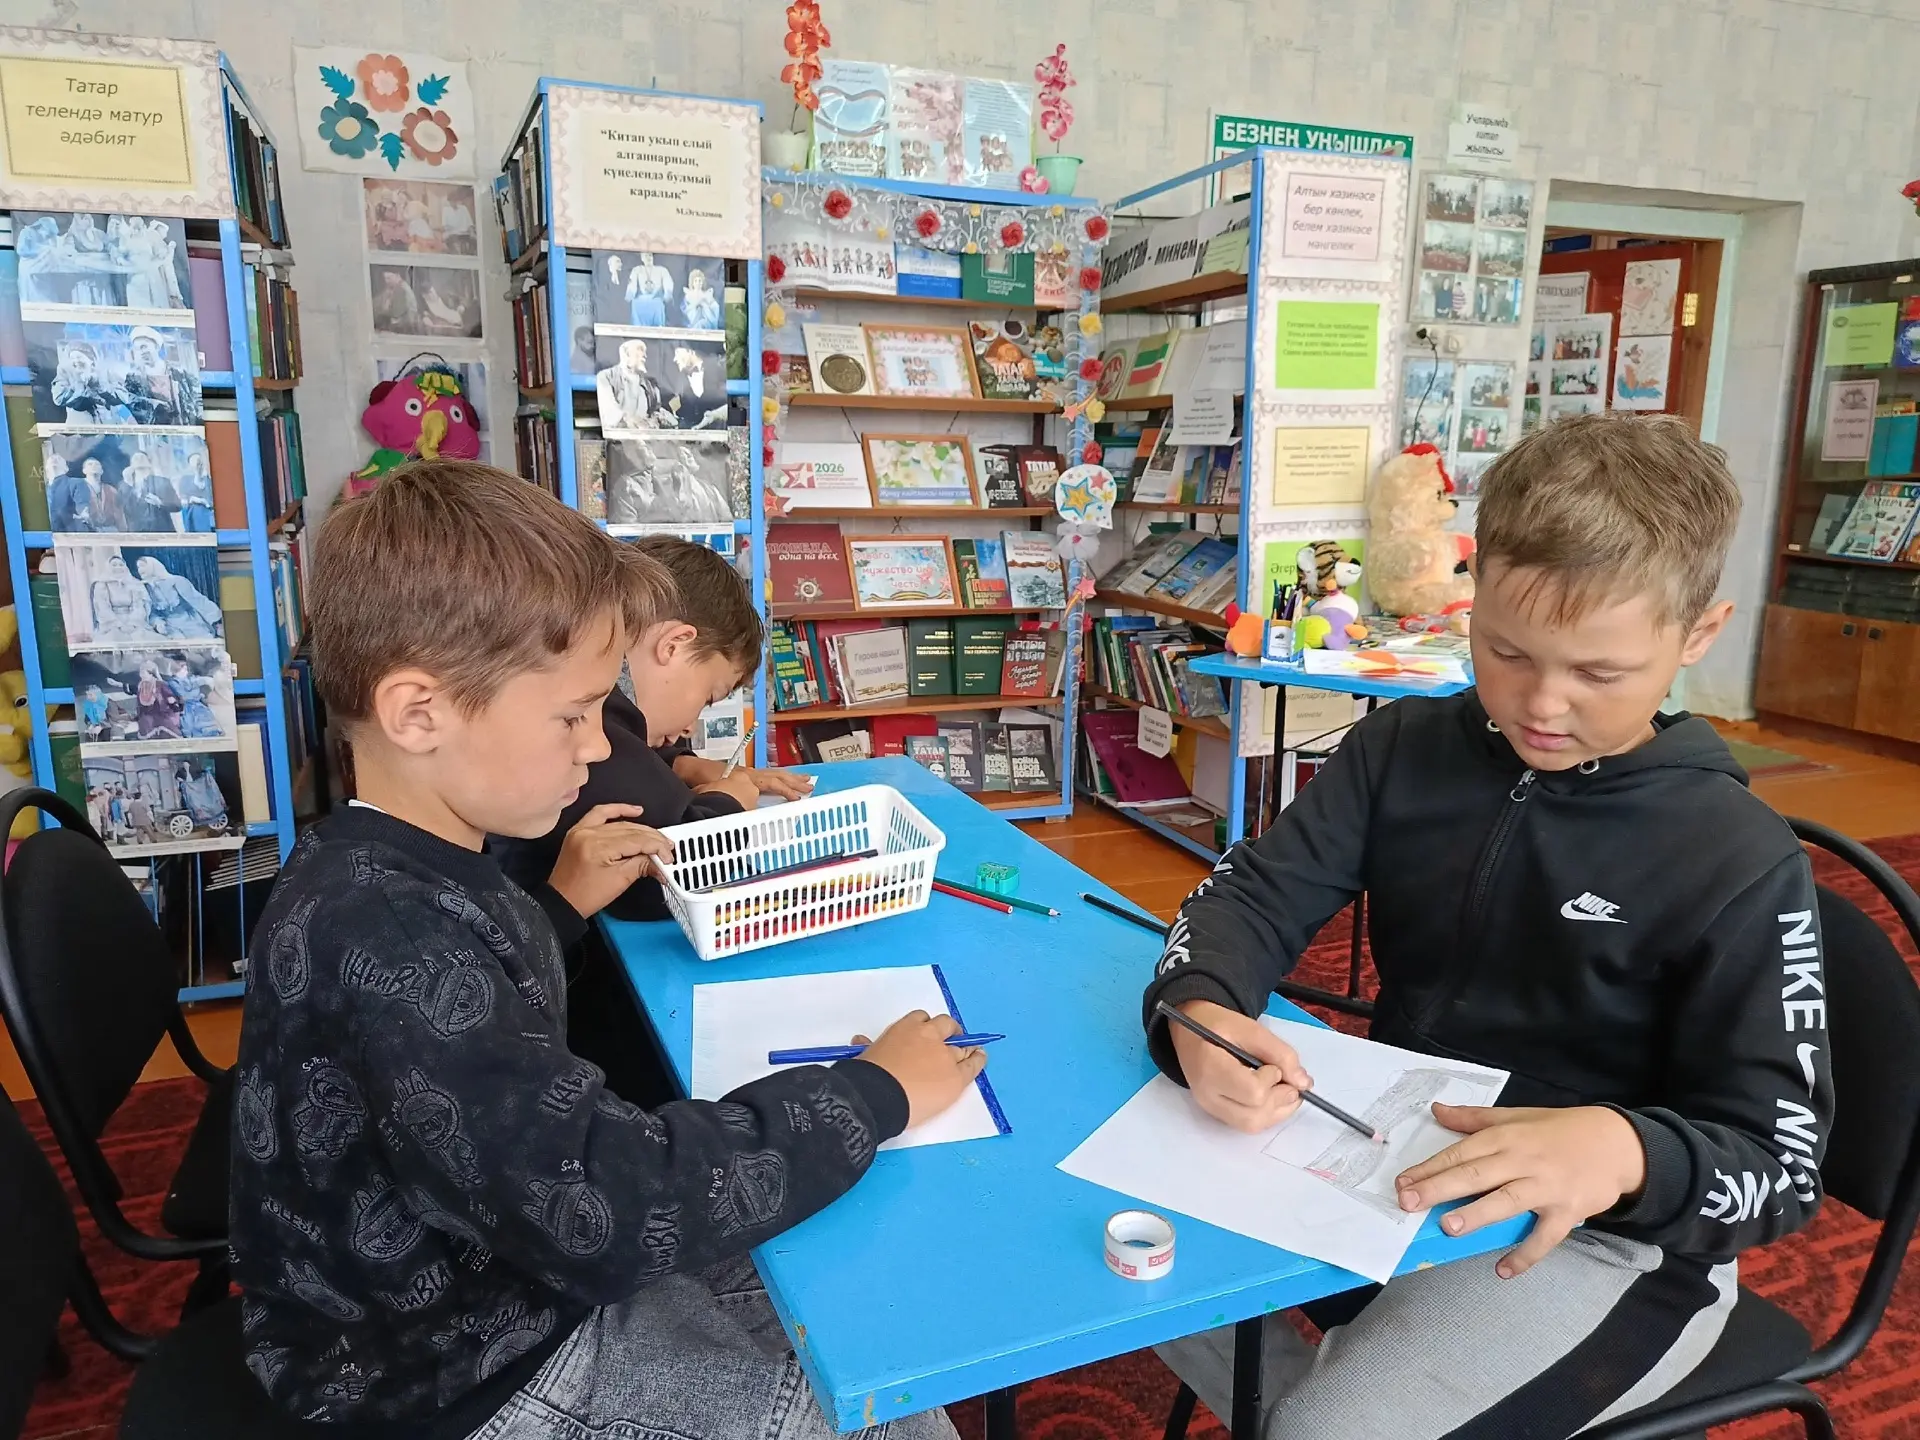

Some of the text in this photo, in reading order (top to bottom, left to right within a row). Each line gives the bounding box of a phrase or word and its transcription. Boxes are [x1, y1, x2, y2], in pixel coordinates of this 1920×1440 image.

[66, 77, 118, 97] Татар
[26, 104, 163, 126] телендә матур
[60, 130, 136, 145] әдәбият
[1222, 121, 1299, 148] БЕЗНЕҢ
[1294, 185, 1327, 198] Алтын
[1303, 203, 1323, 215] бер
[1292, 220, 1323, 232] белем
[1154, 237, 1198, 266] минем
[814, 463, 845, 473] 2026
[767, 542, 833, 555] ПОБЕДА
[778, 549, 840, 561] одна на всех
[862, 566, 913, 577] мужество
[829, 743, 862, 758] ГЕРОИ
[1011, 756, 1040, 765] ВОЙНА
[1013, 769, 1046, 778] ПОБЕДА
[1573, 891, 1620, 918] NIKE
[1777, 909, 1826, 1032] NIKE
